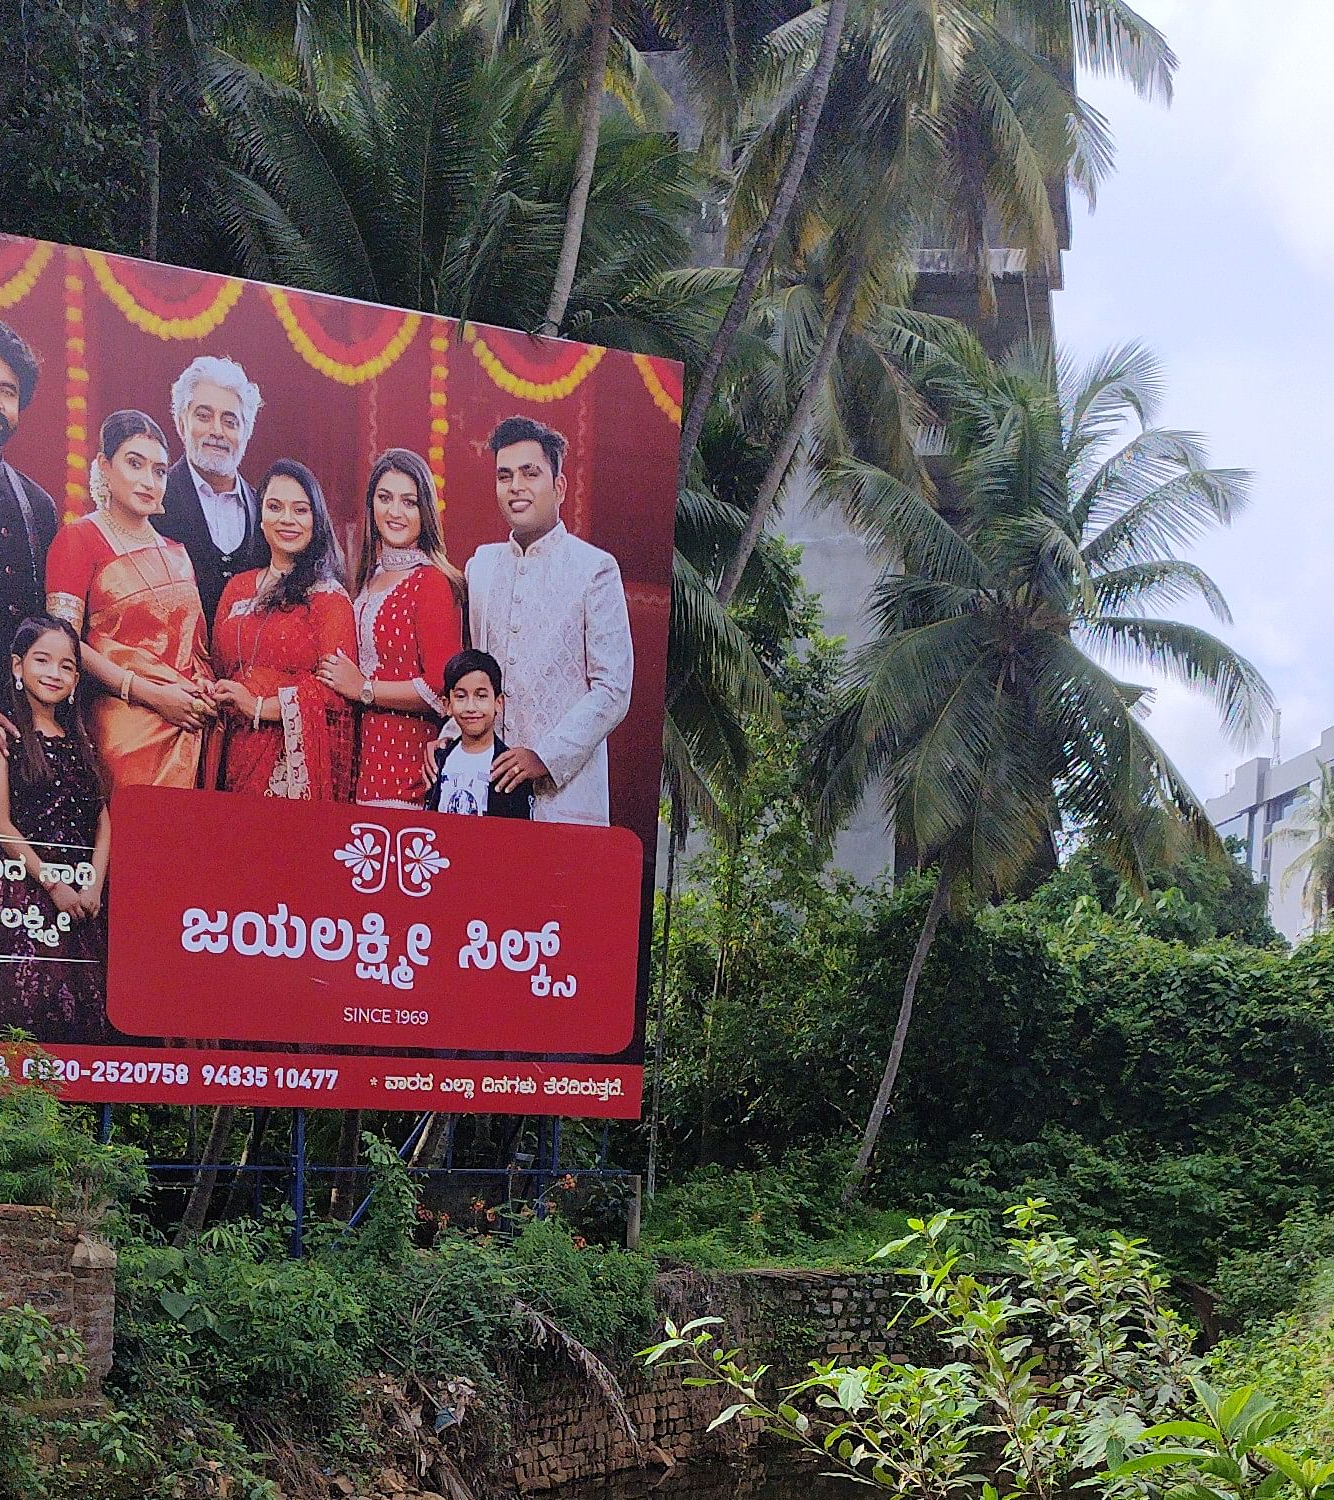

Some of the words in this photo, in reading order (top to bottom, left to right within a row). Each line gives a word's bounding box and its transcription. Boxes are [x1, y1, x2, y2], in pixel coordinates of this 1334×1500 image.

[181, 903, 432, 989] ಜಯಲಕ್ಷ್ಮೀ
[458, 919, 577, 998] ಸಿಲ್ಕ್ಸ್
[343, 1007, 391, 1024] SINCE
[395, 1009, 429, 1025] 1969
[201, 1064, 267, 1087] 94835
[274, 1067, 338, 1090] 10477
[385, 1073, 433, 1092] ವಾರದ
